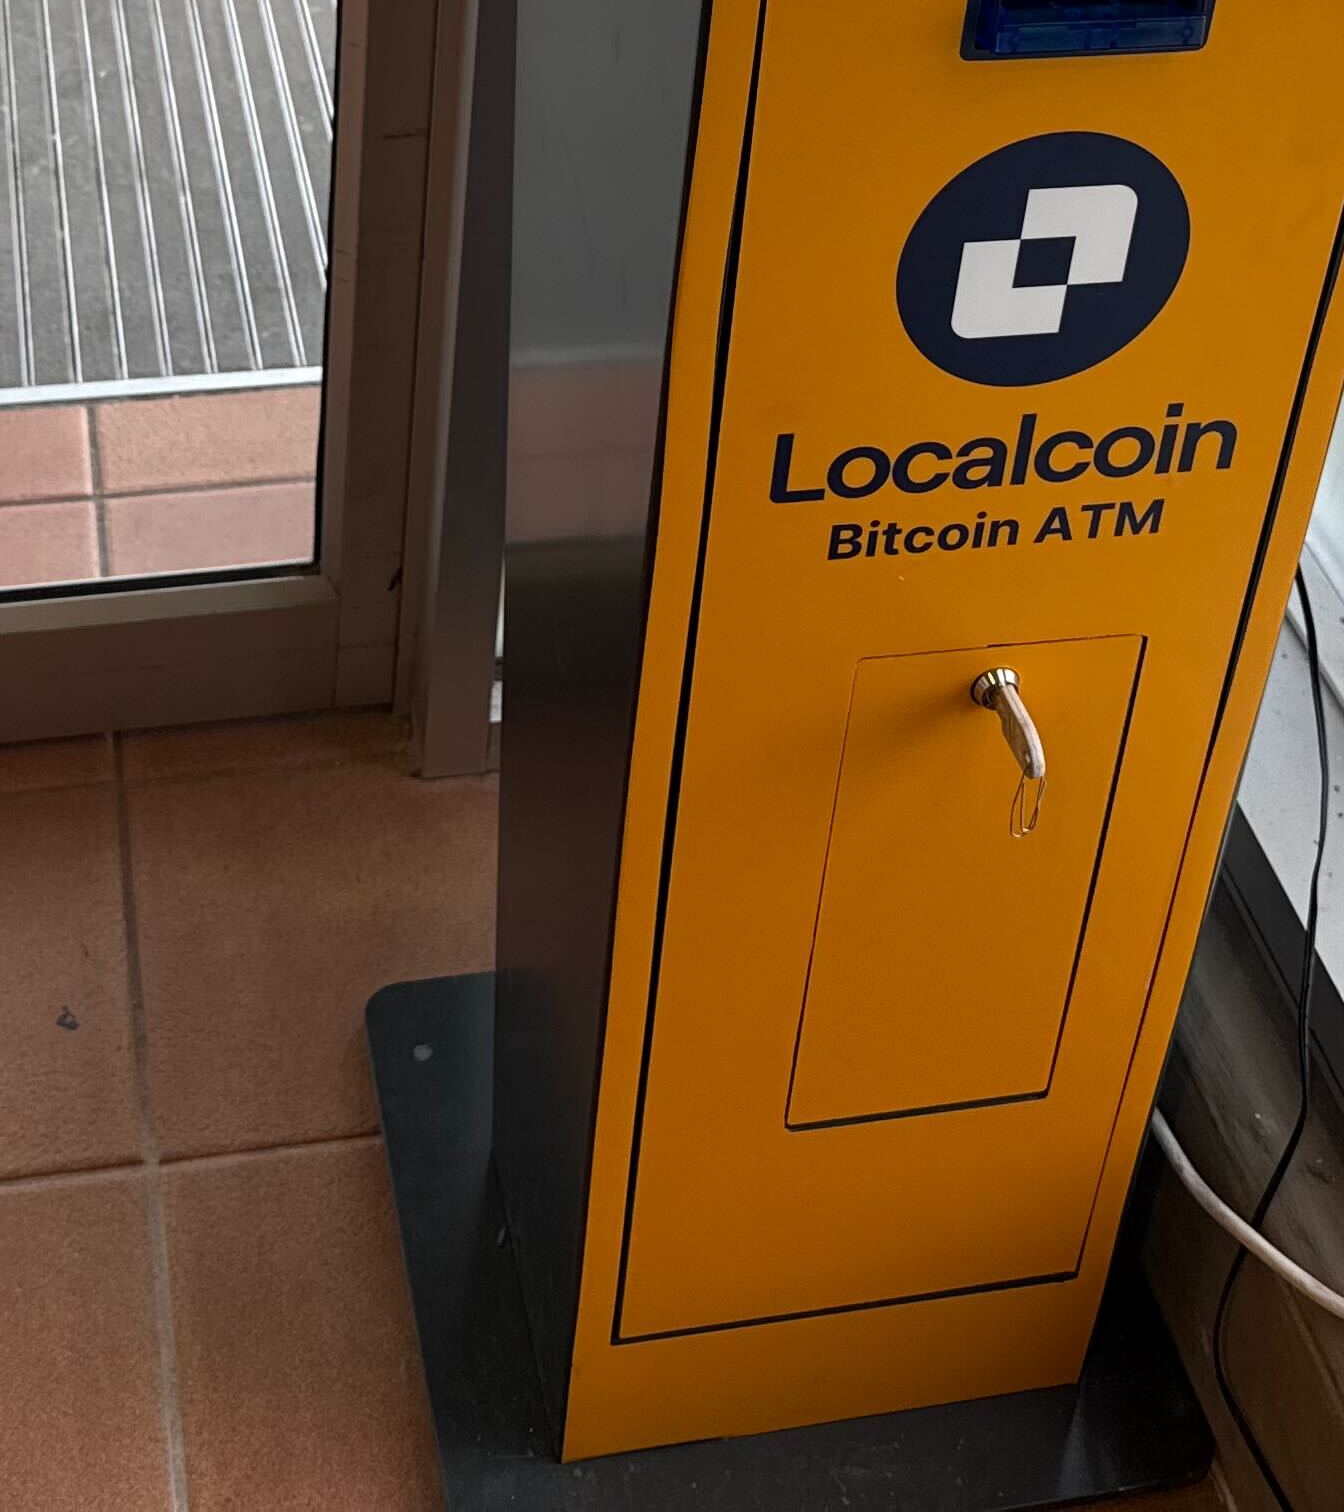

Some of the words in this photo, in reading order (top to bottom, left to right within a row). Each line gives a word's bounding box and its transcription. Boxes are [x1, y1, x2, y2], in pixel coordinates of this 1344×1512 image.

[768, 402, 1239, 504] Localcoin
[826, 511, 1020, 561] Bitcoin
[1032, 498, 1165, 545] ATM
